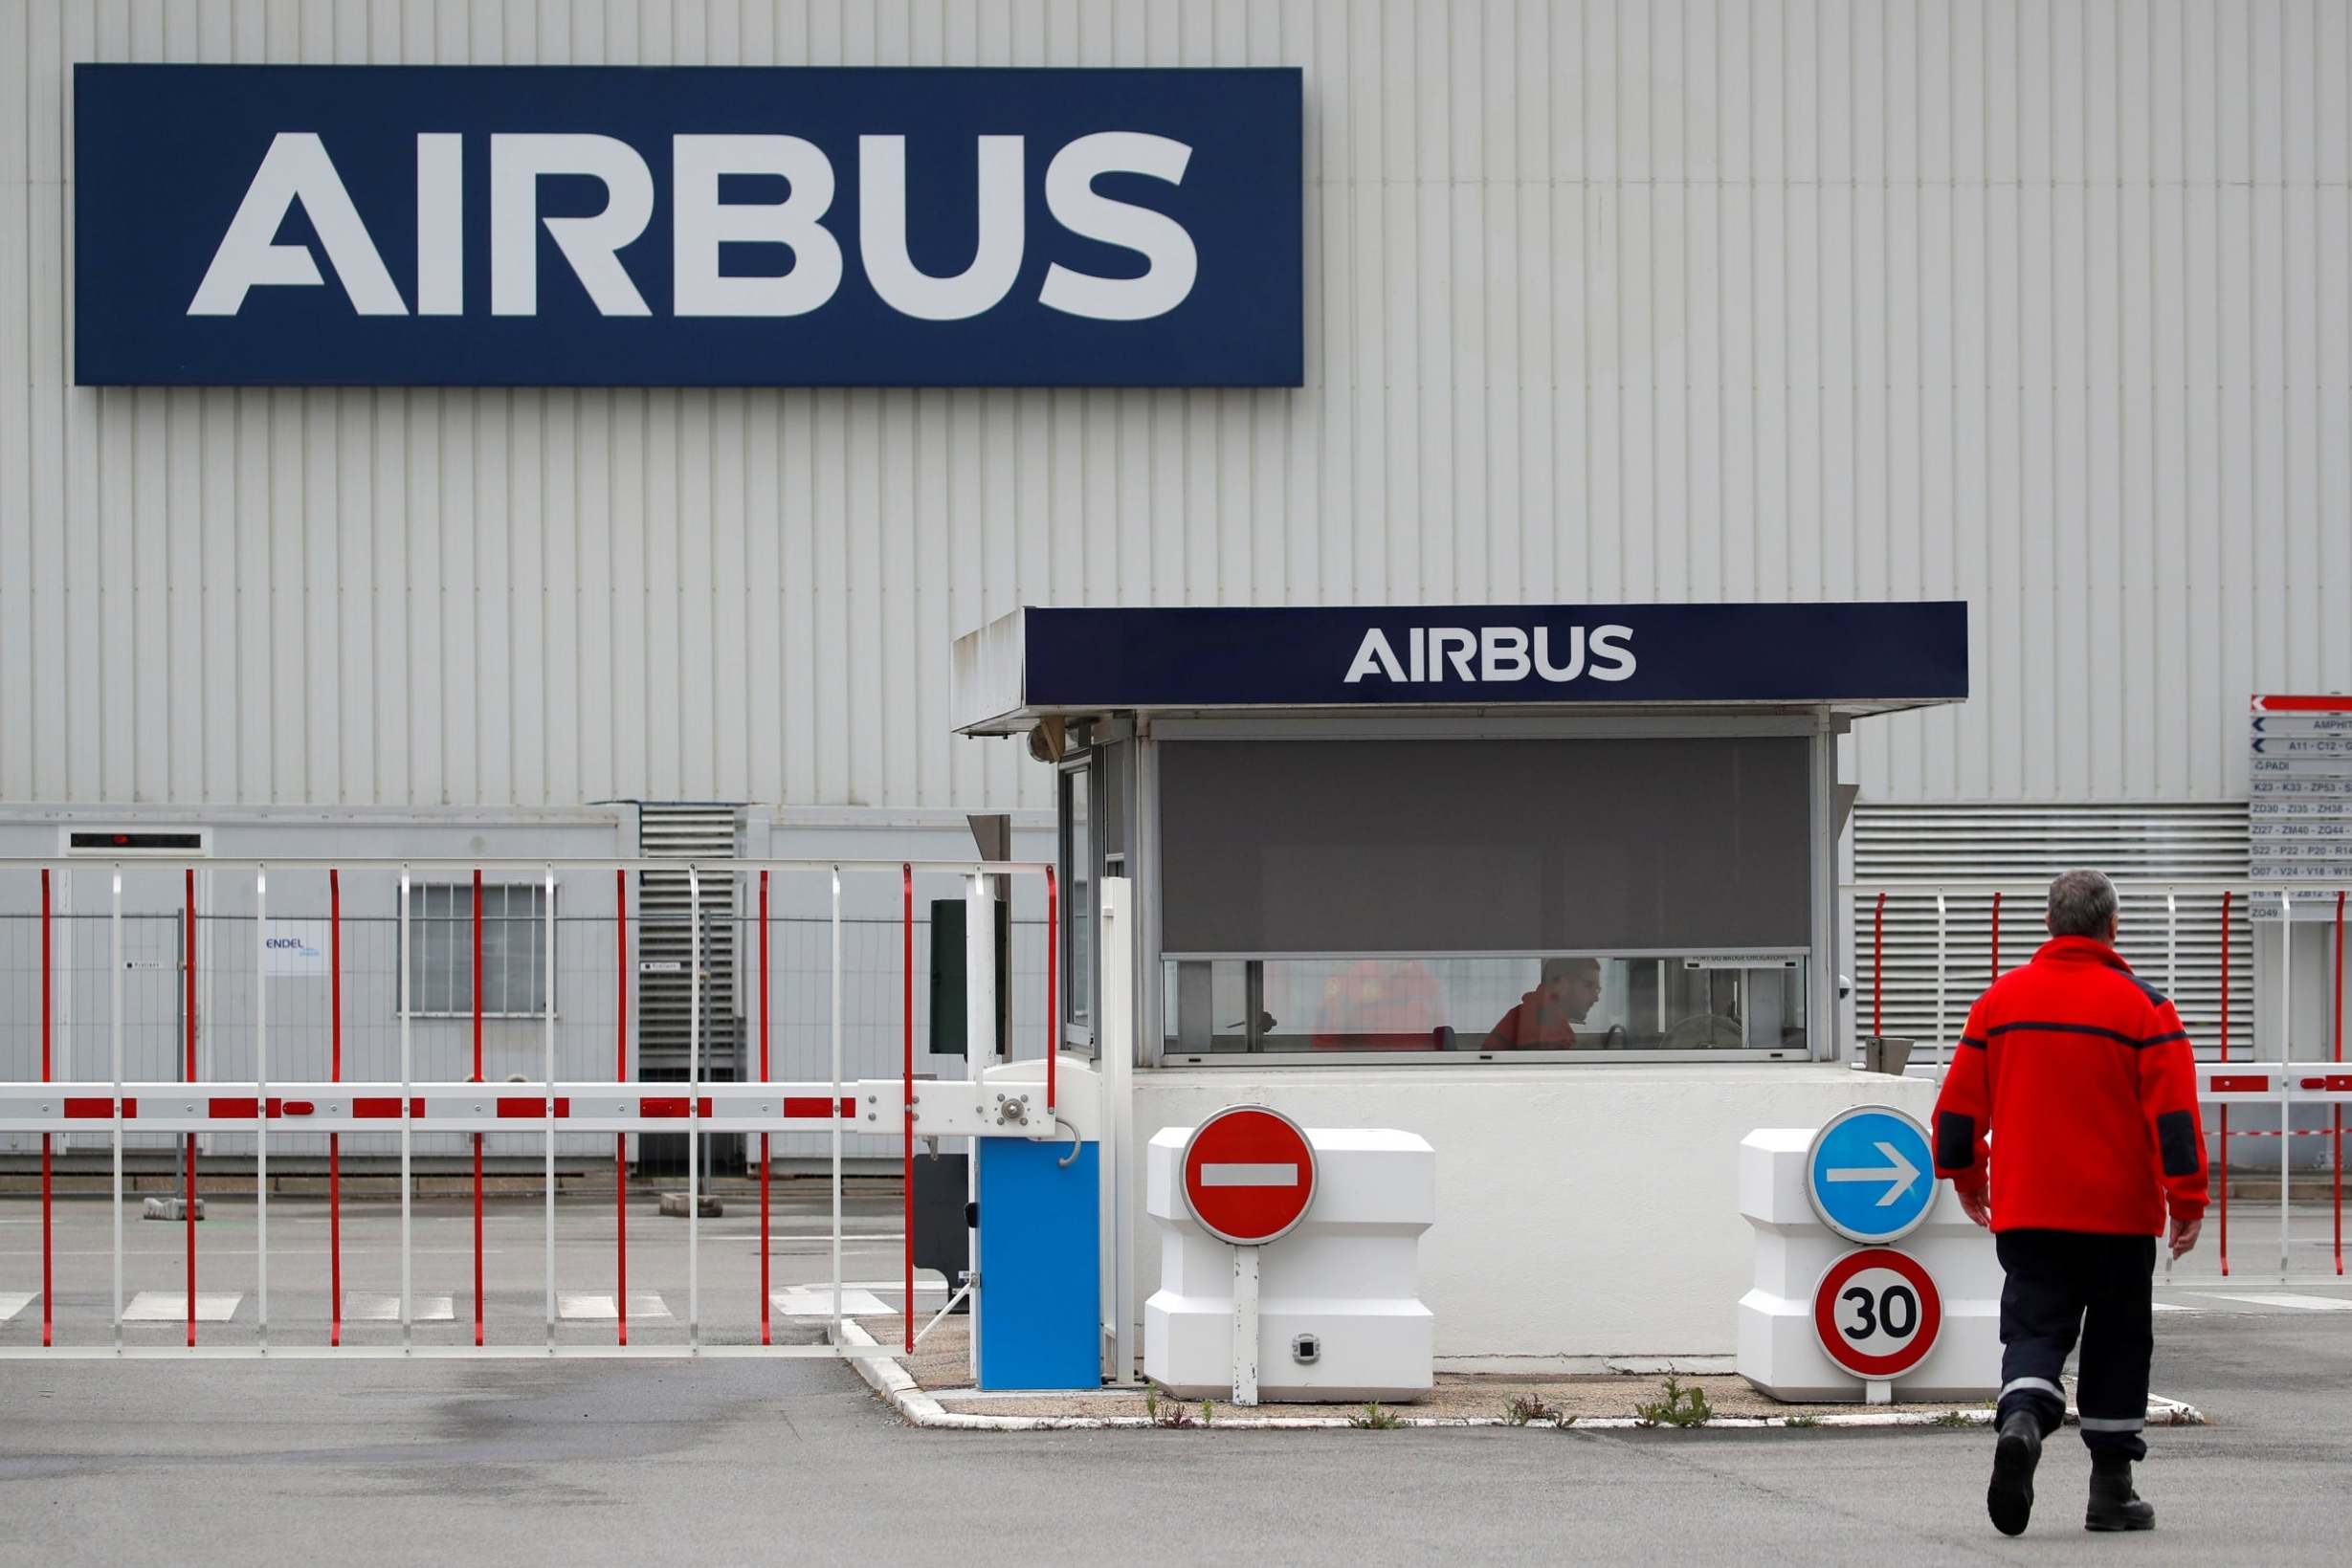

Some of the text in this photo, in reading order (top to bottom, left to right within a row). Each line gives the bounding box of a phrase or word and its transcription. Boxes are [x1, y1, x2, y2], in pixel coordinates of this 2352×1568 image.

[187, 131, 1198, 321] AIRBUS
[1343, 625, 1637, 683] AIRBUS
[2289, 741, 2307, 750] A11
[2317, 741, 2337, 750] C12
[266, 938, 304, 949] ENDEL
[1841, 1285, 1918, 1340] 30
